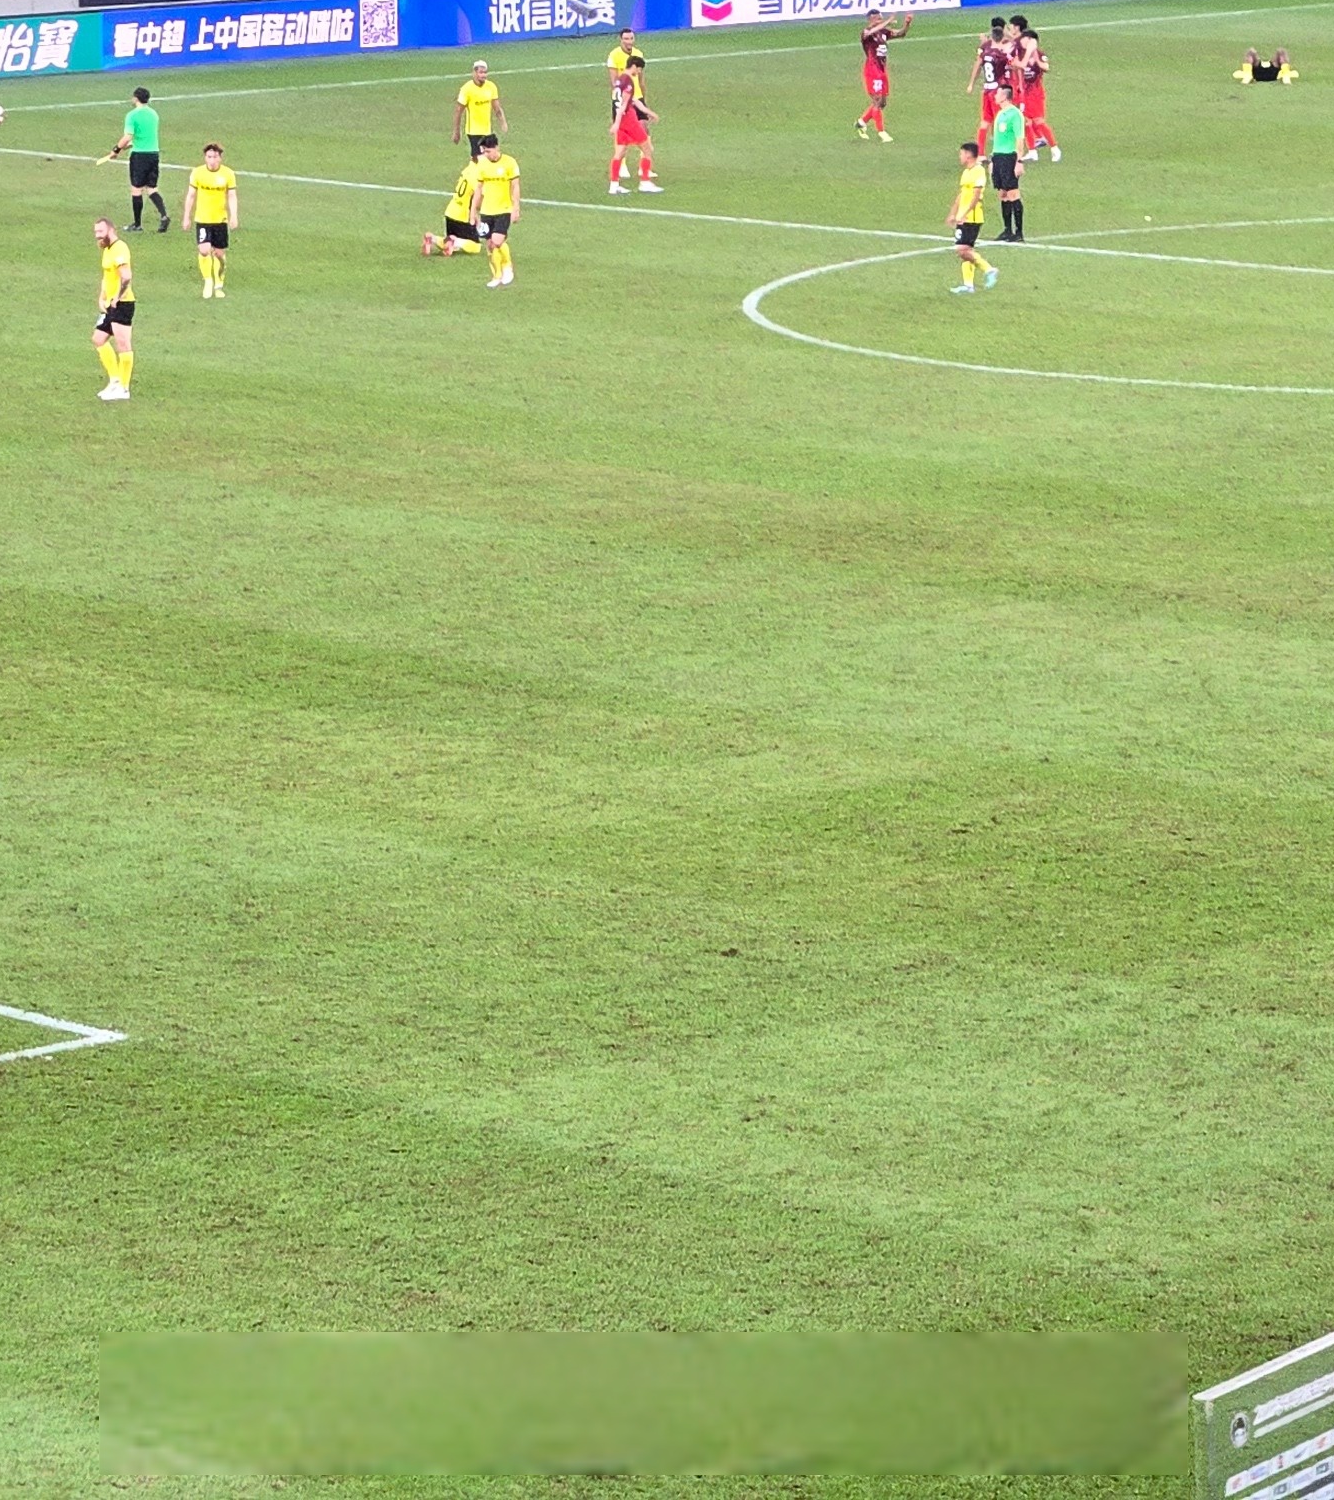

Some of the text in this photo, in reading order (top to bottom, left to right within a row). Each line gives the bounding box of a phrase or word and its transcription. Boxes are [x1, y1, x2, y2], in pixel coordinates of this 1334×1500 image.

[113, 8, 355, 58] 看中超 上中国移动咪咕
[983, 61, 995, 83] 8
